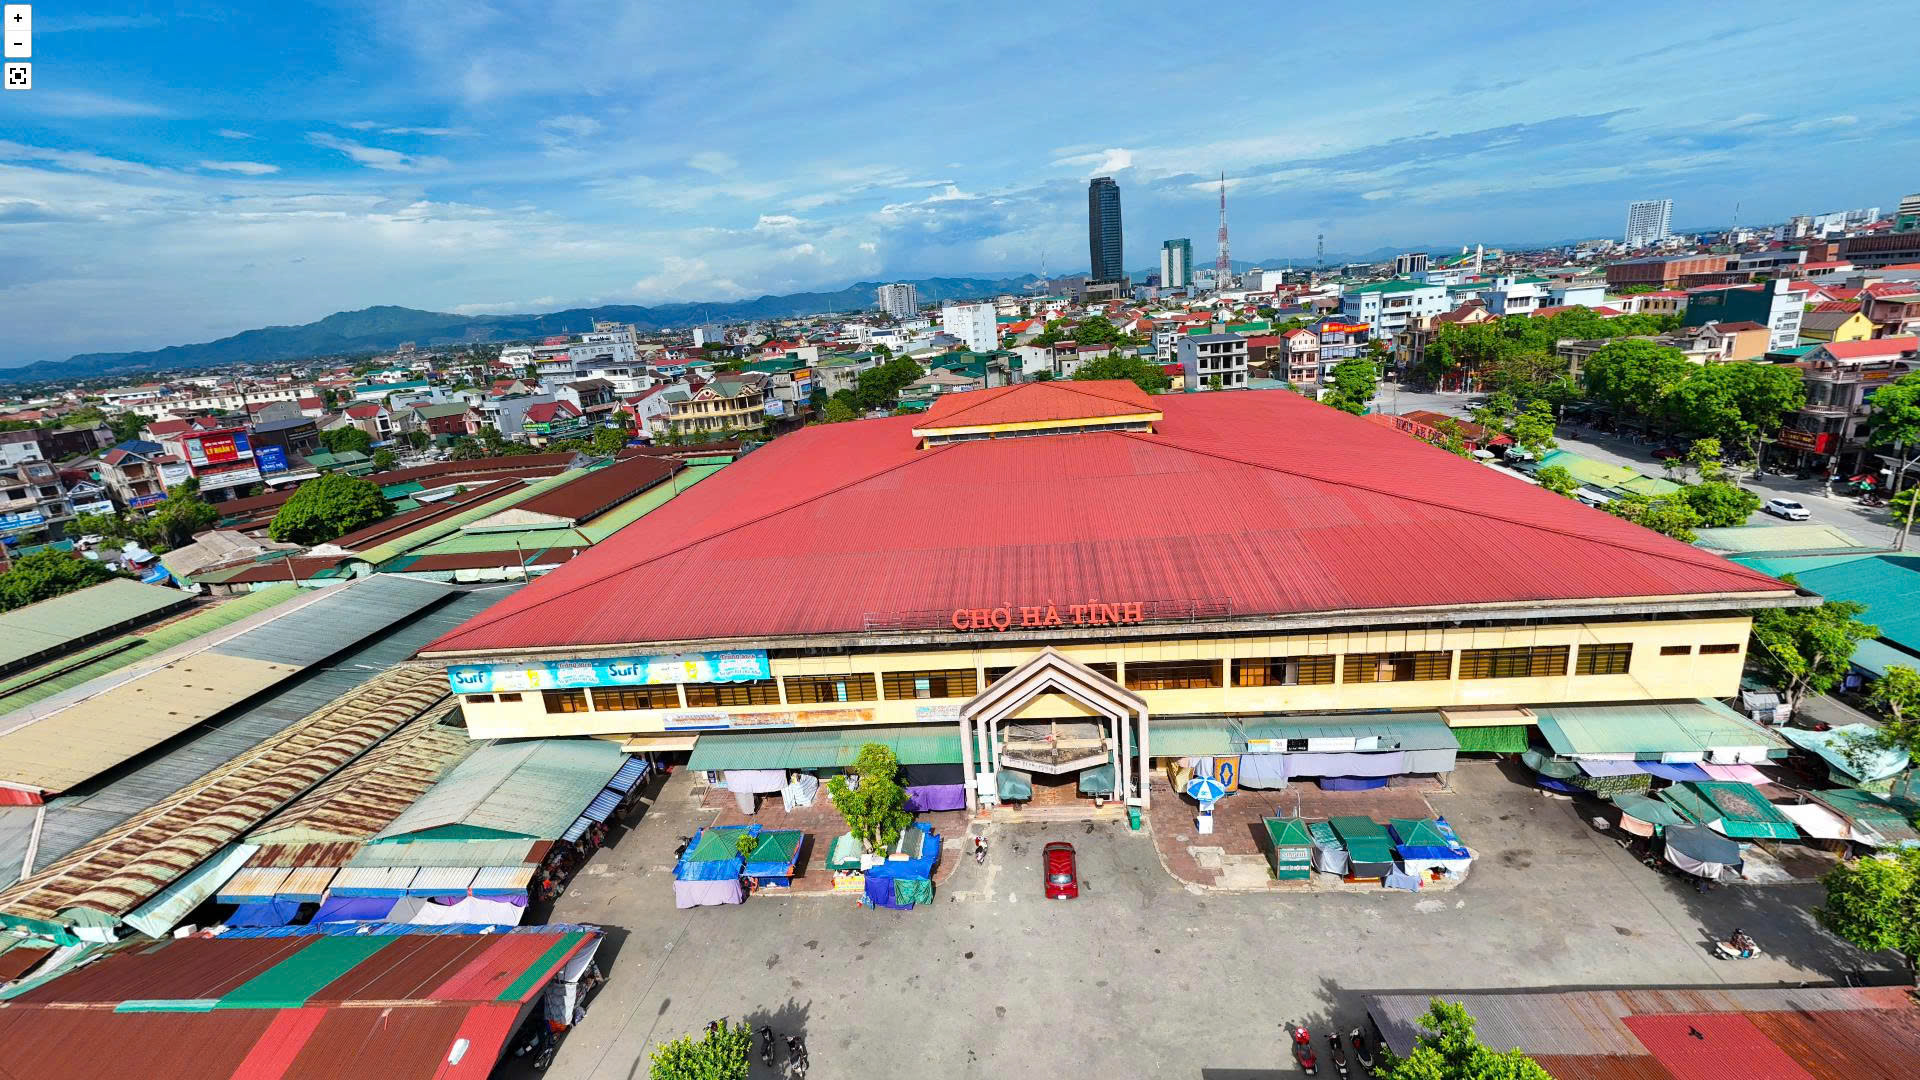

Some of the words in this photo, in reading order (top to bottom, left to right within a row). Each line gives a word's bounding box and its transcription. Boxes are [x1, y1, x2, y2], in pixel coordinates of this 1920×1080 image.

[952, 602, 1011, 632] CHỢ
[1020, 599, 1062, 627] HÀ
[1070, 598, 1144, 625] TĨNH
[608, 662, 639, 677] Surf
[455, 671, 484, 684] Surf
